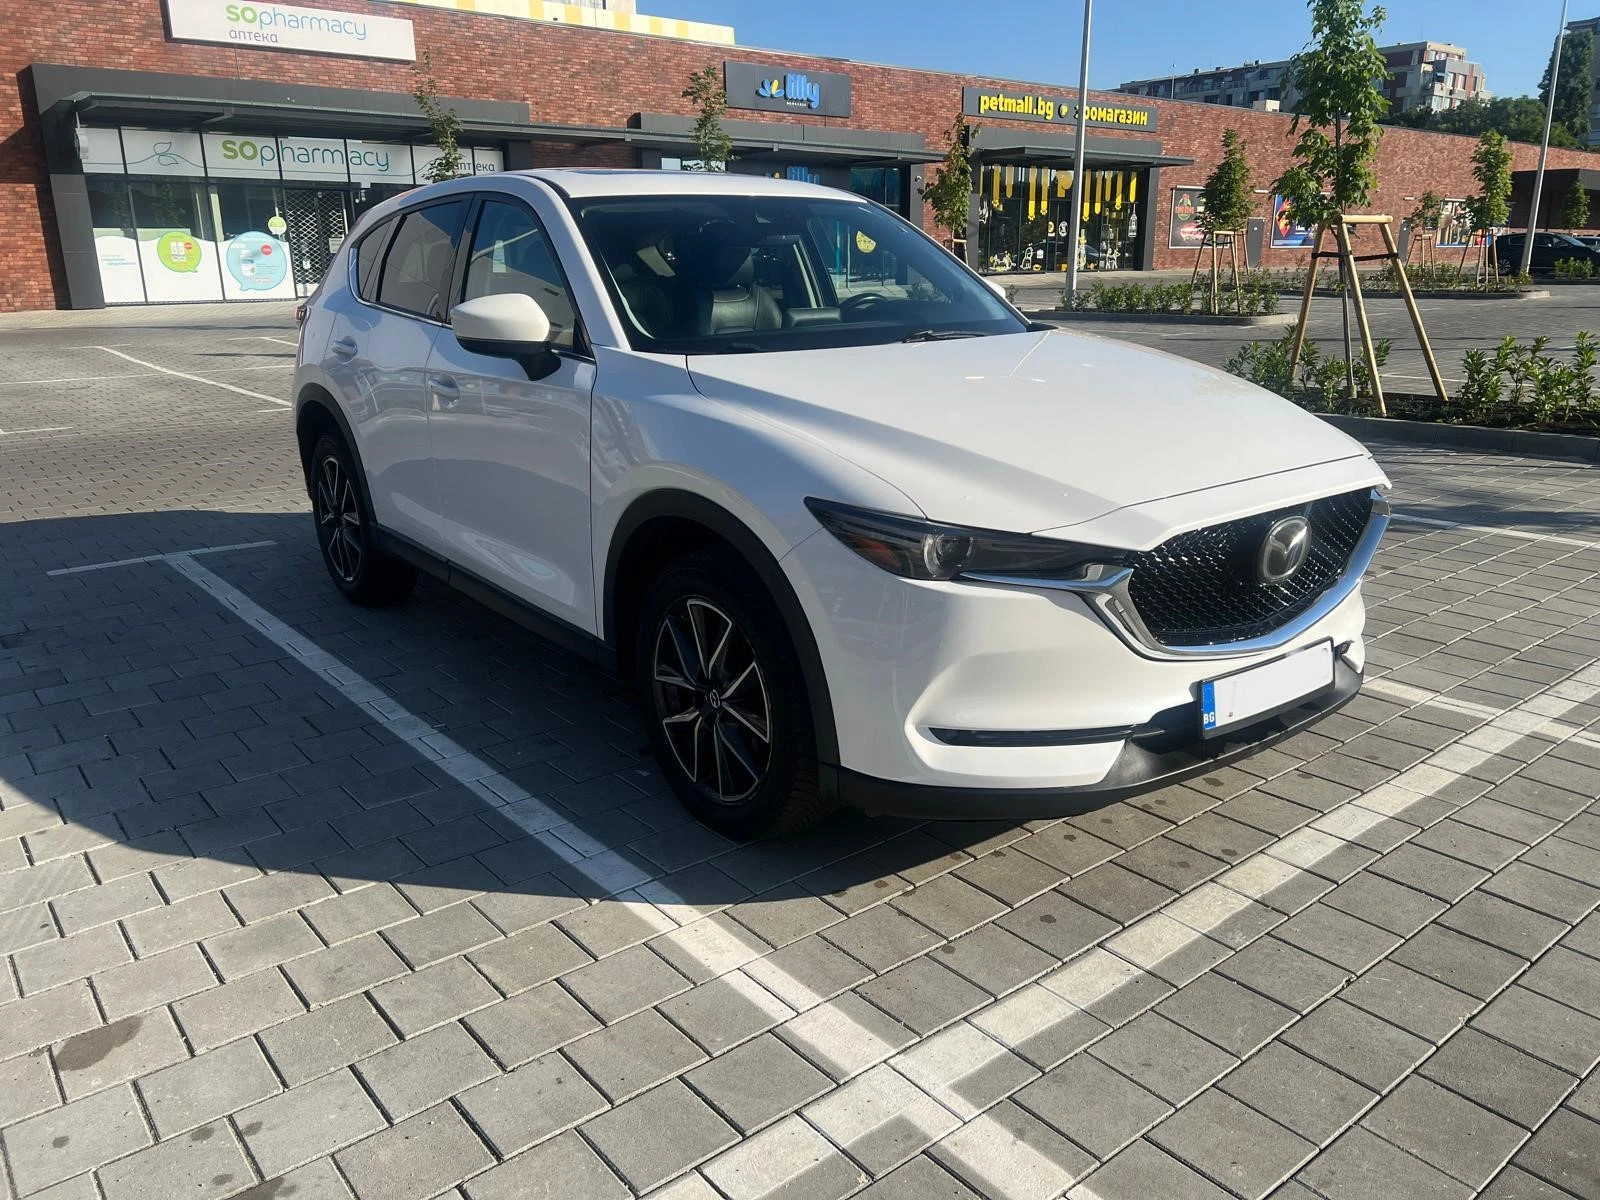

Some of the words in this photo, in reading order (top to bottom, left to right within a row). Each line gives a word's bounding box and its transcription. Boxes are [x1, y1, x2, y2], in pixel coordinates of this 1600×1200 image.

[229, 29, 278, 43] аптека
[786, 73, 820, 109] lilly
[979, 94, 1054, 120] petmall.bg
[1203, 711, 1215, 724] BG
